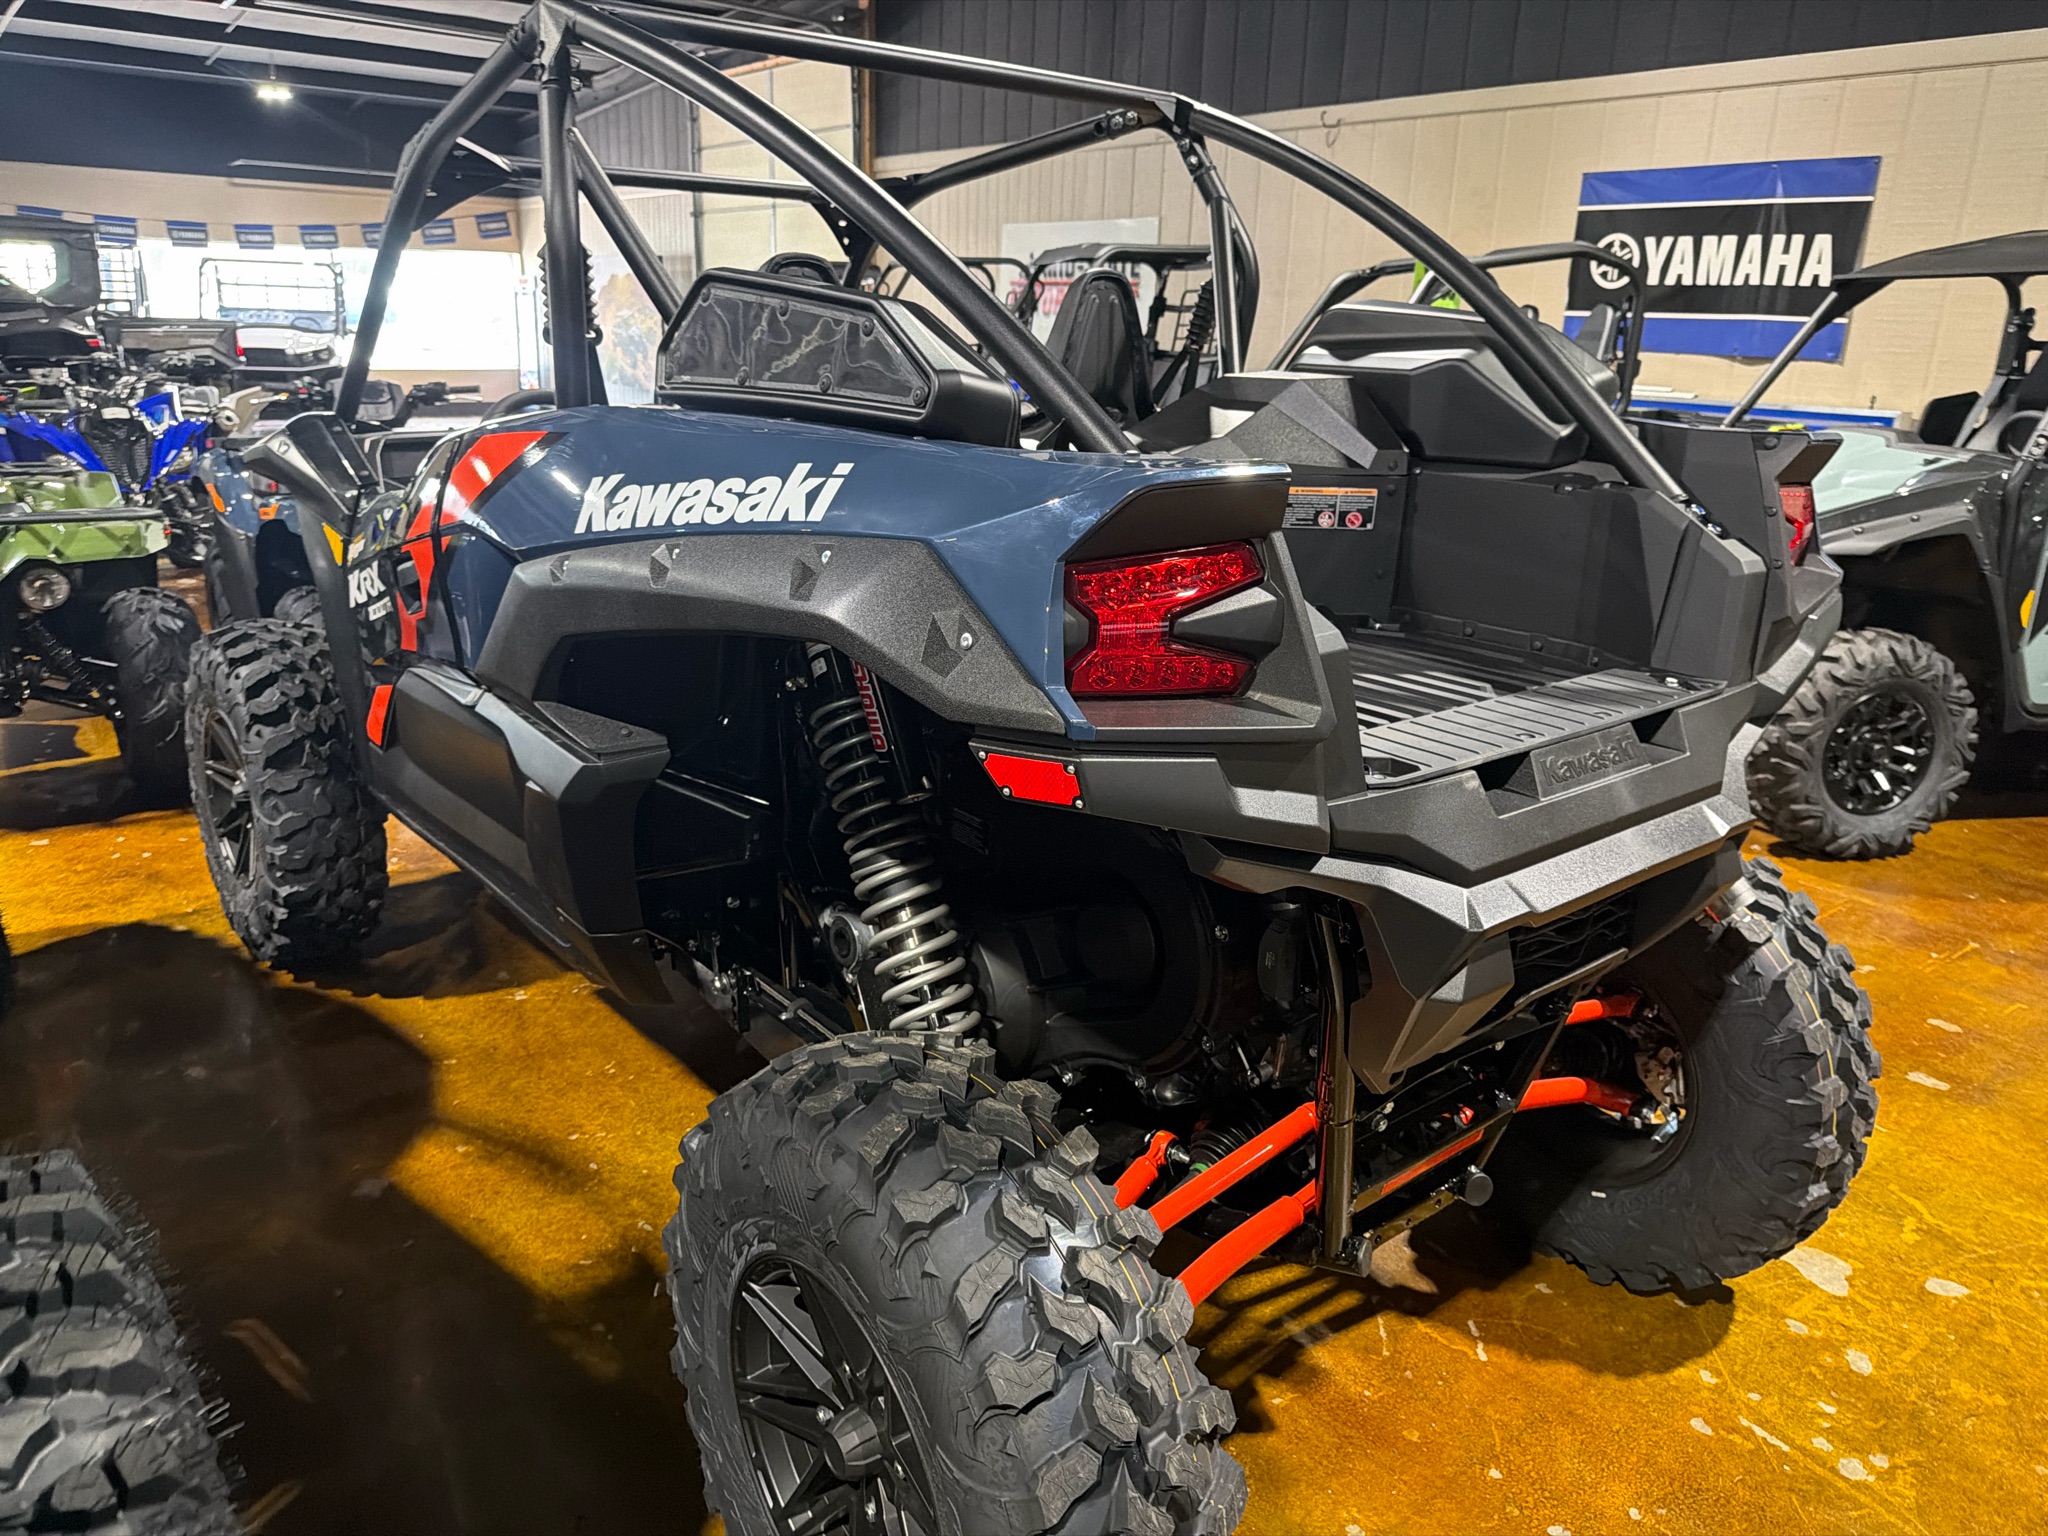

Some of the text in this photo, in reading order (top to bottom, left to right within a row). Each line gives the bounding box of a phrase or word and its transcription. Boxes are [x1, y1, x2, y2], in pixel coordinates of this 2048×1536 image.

[1643, 233, 1833, 288] YAMAHA
[573, 462, 856, 535] Kawasaki
[348, 560, 387, 608] KRX
[1539, 733, 1636, 786] Kawasaki
